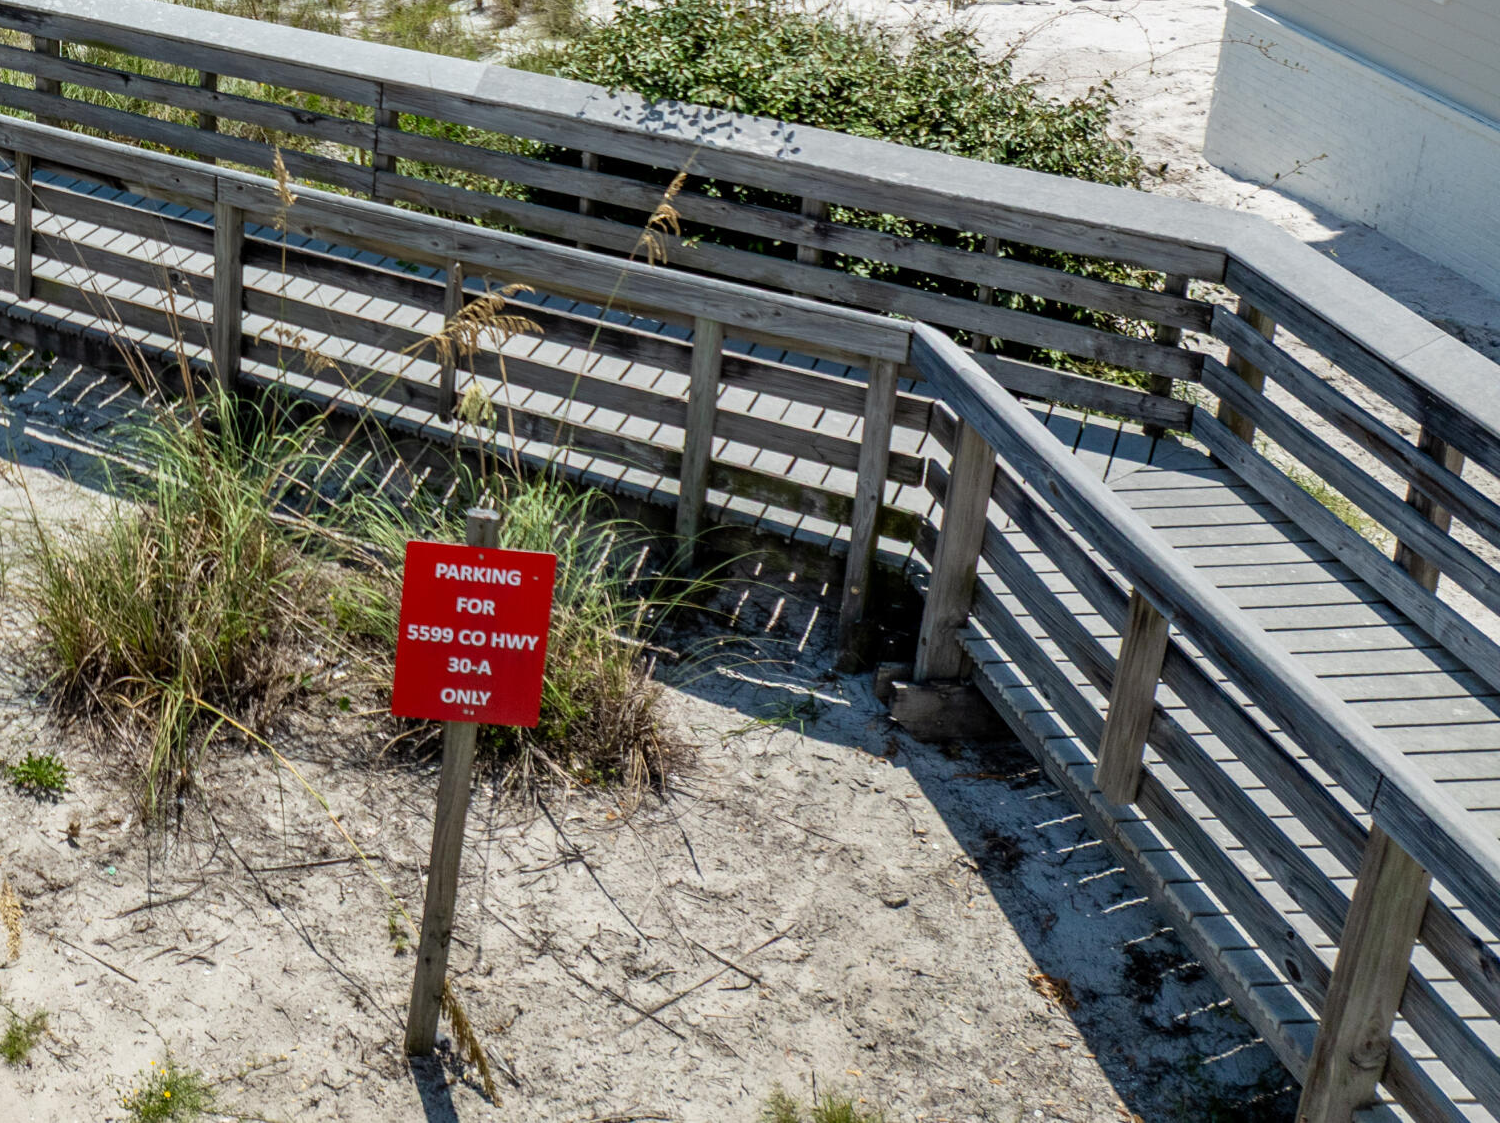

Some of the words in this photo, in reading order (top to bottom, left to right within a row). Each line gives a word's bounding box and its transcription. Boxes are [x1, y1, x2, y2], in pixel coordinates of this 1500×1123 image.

[435, 563, 522, 586] PARKING
[457, 597, 495, 615] FOR
[407, 624, 453, 643] 5599
[458, 630, 486, 646] CO
[491, 632, 539, 651] HWY
[447, 657, 491, 675] 30-A
[441, 688, 491, 706] ONLY
